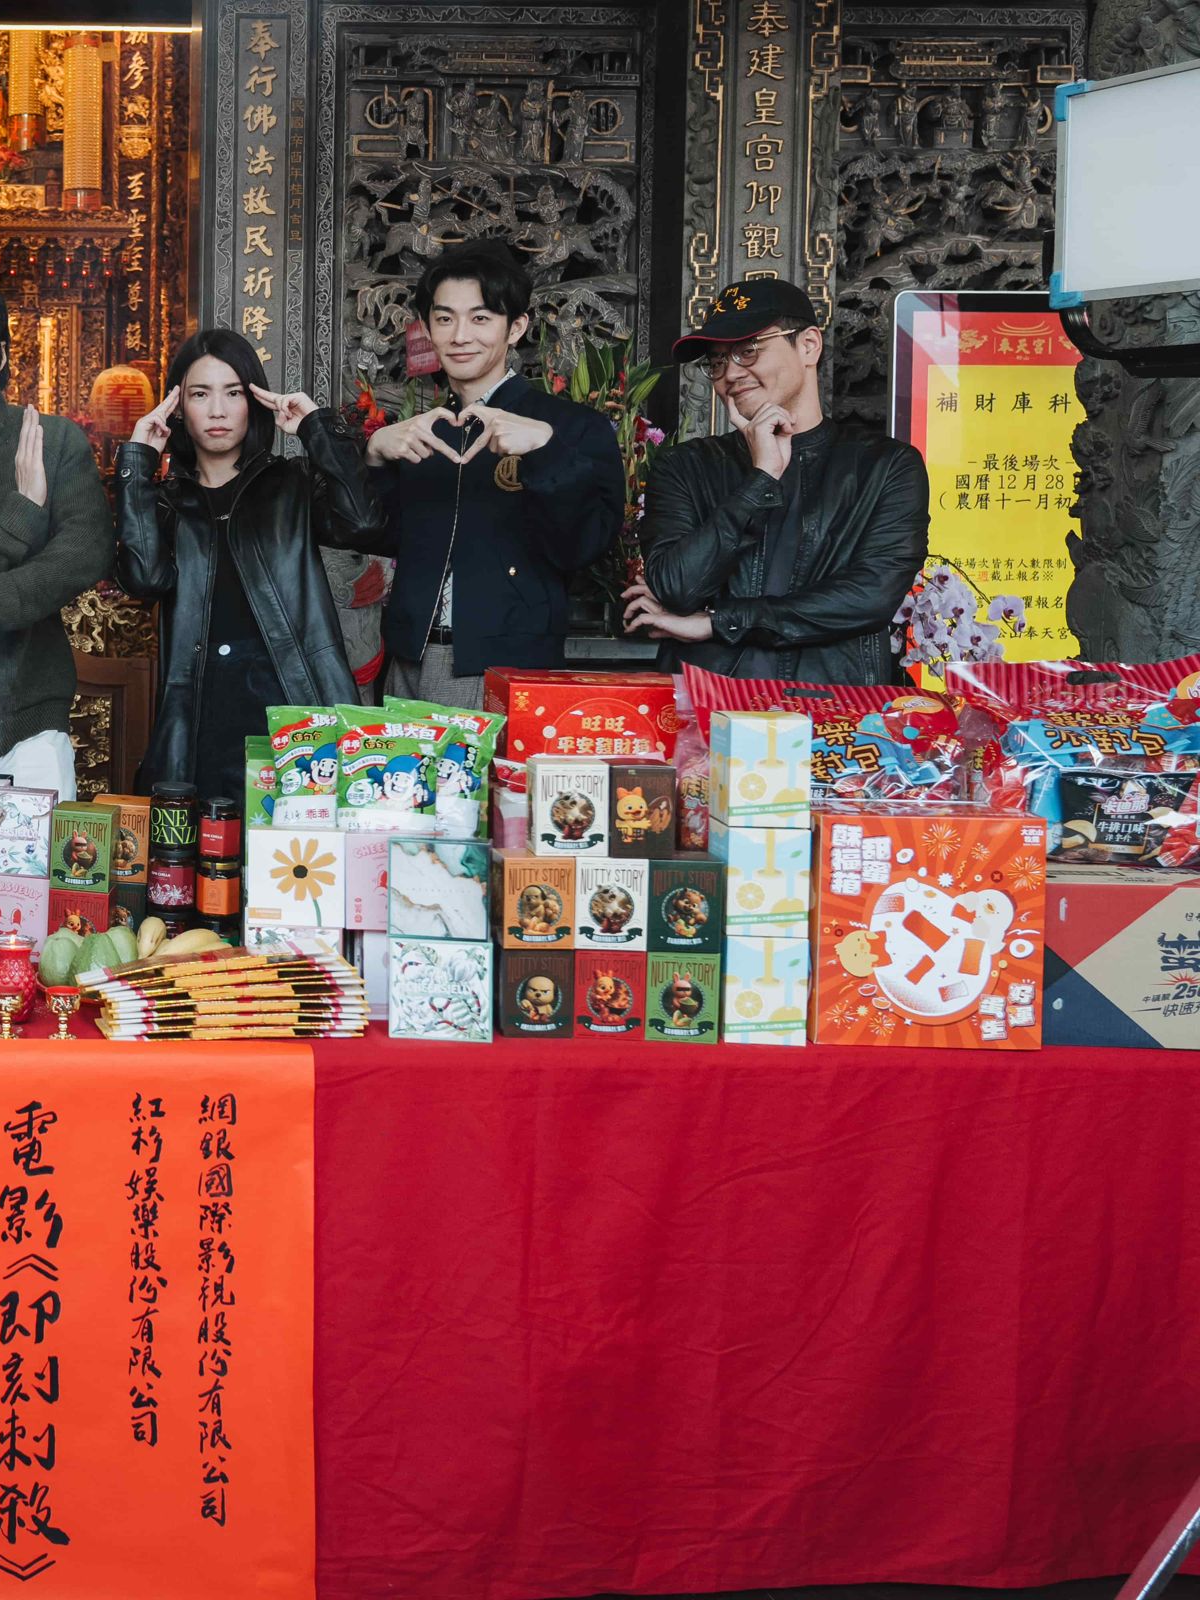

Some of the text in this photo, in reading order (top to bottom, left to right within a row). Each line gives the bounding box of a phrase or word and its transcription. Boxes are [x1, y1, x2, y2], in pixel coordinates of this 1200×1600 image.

[581, 715, 626, 733] 旺旺
[151, 807, 188, 827] ONE
[54, 818, 109, 847] NUTTY STORY
[509, 868, 572, 895] NUTTY STORY
[580, 868, 644, 895] NUTTY STORY
[651, 960, 716, 989] NUTTY STORY
[198, 1092, 238, 1528] 網銀國際影視股份有限公司
